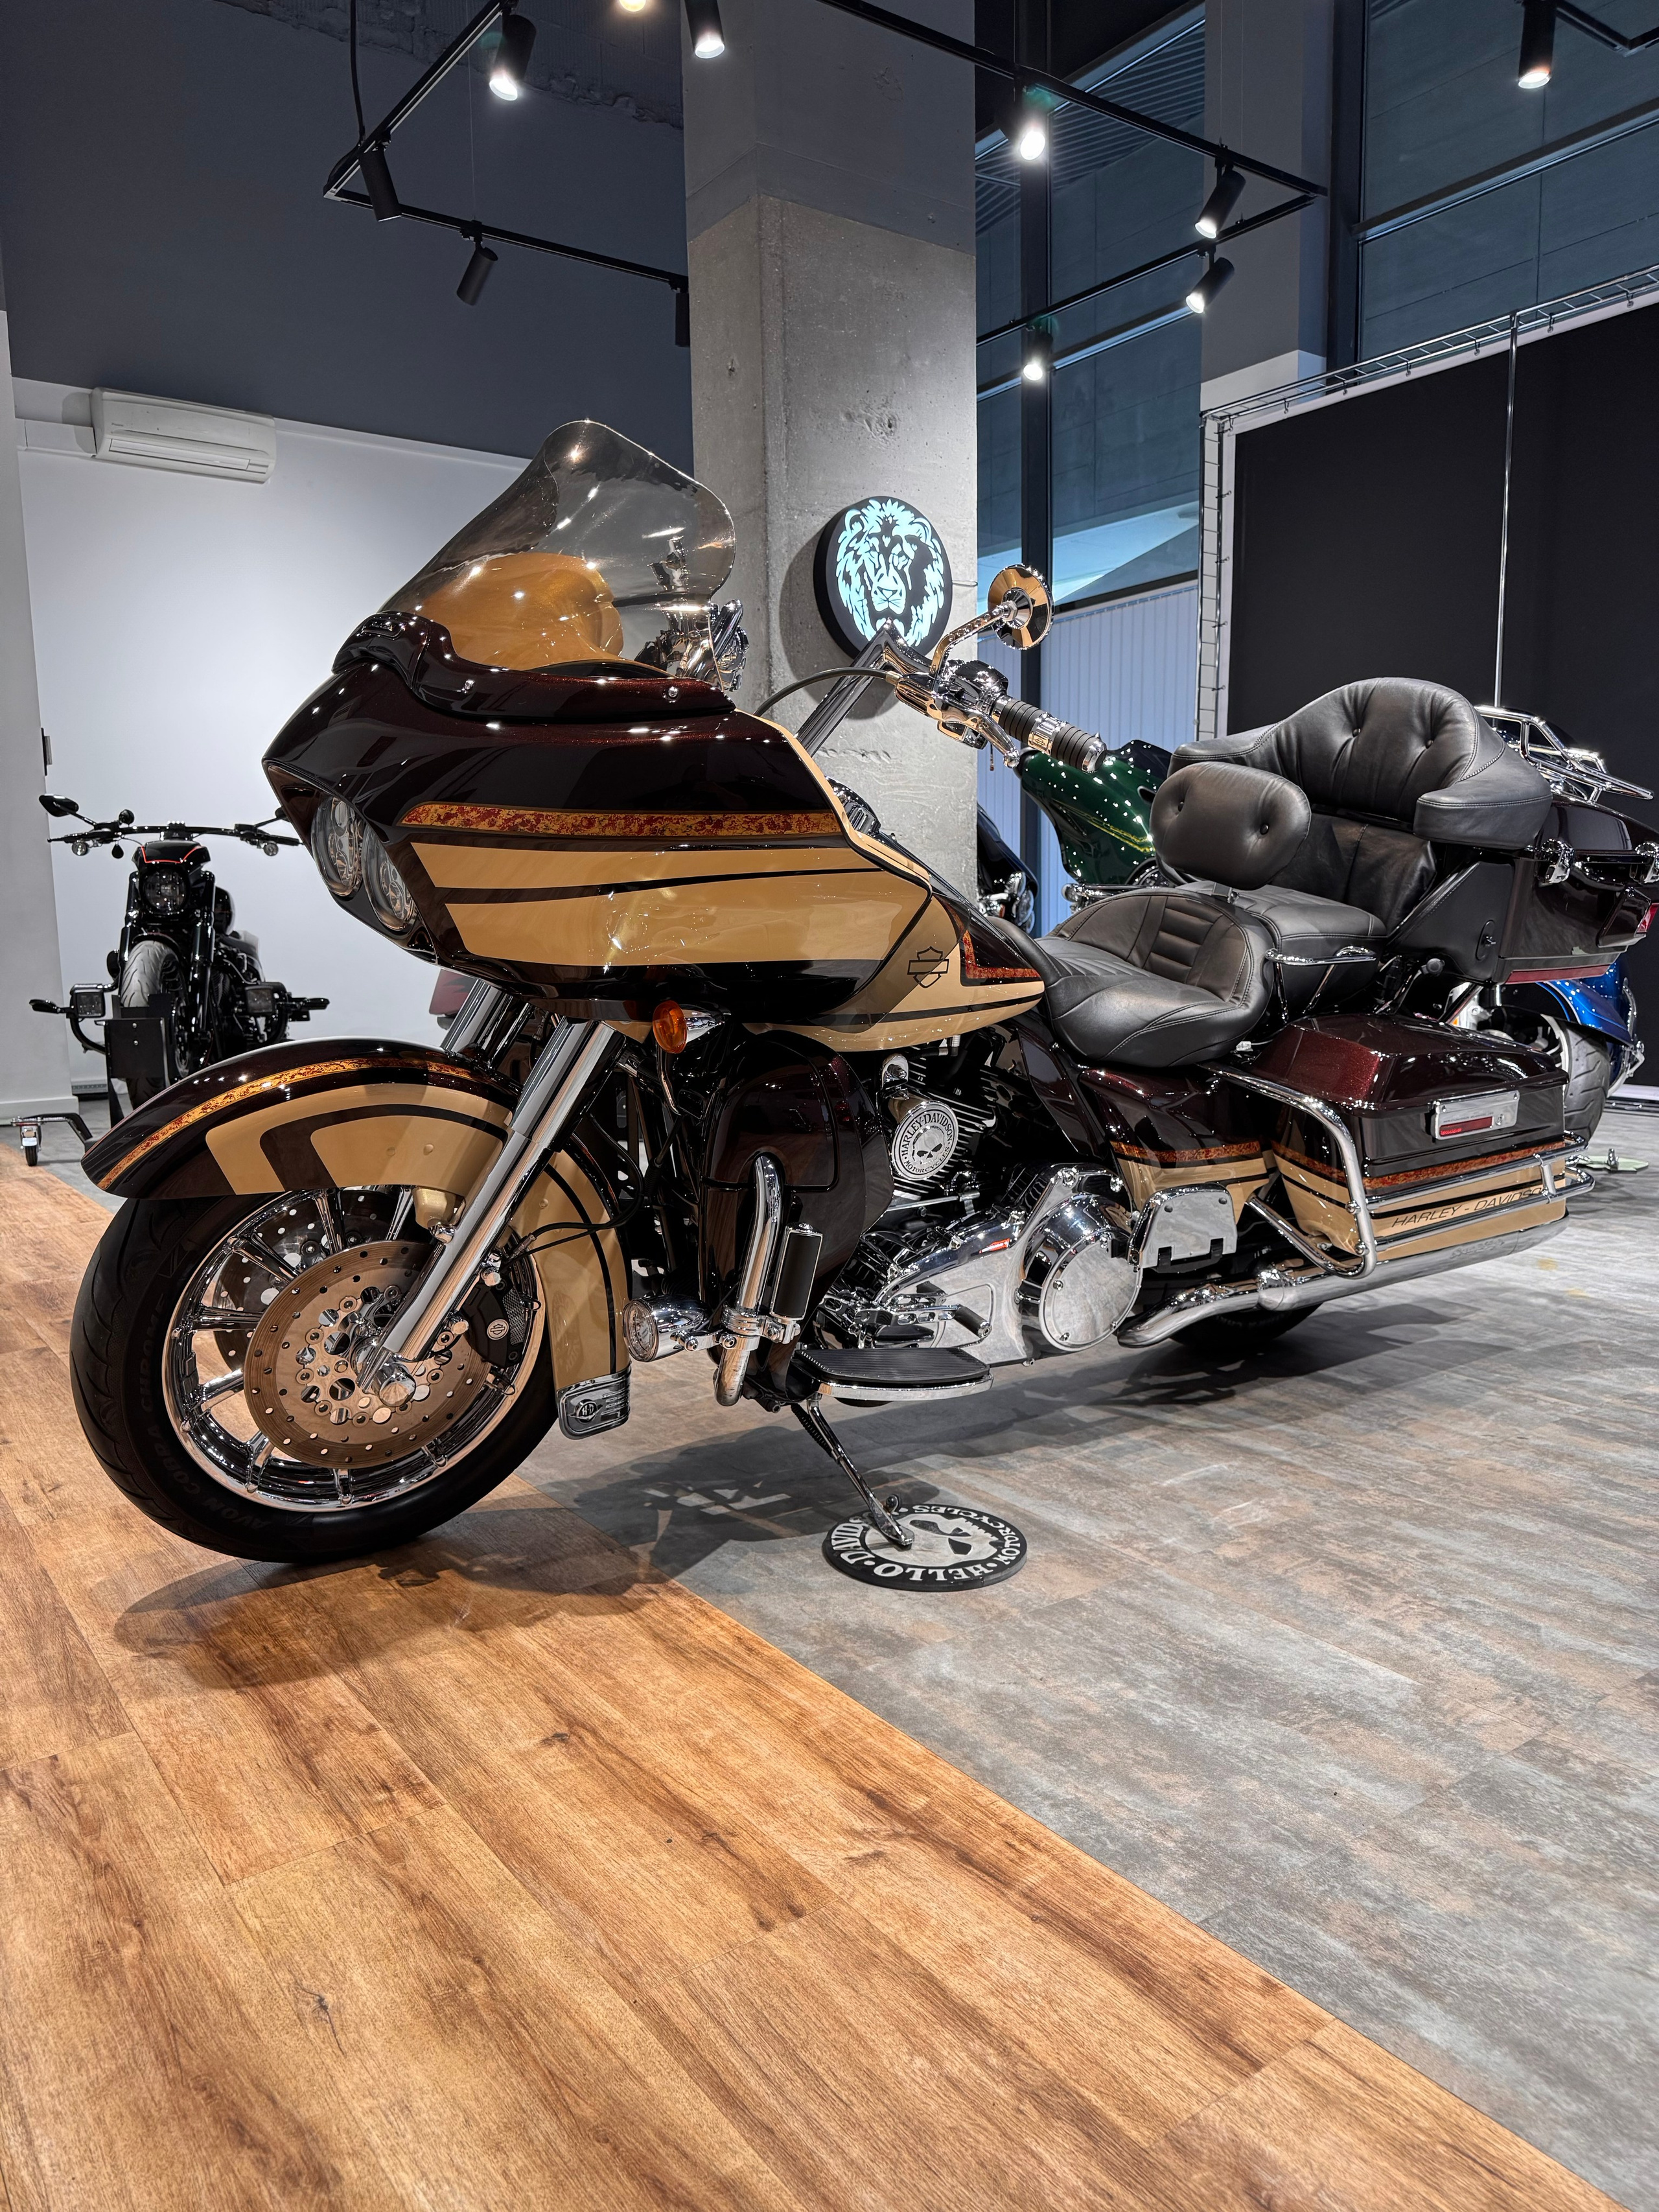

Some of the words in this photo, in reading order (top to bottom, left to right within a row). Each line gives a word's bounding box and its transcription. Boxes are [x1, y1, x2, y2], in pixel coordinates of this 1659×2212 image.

[901, 1112, 953, 1156] HARLEY-DAVIDSON
[903, 1147, 950, 1173] MOTORCYCLES
[1391, 1204, 1463, 1228] HARLEY
[1474, 1187, 1543, 1211] DAVIDSO
[912, 1504, 1021, 1565] MOTORCYCLES
